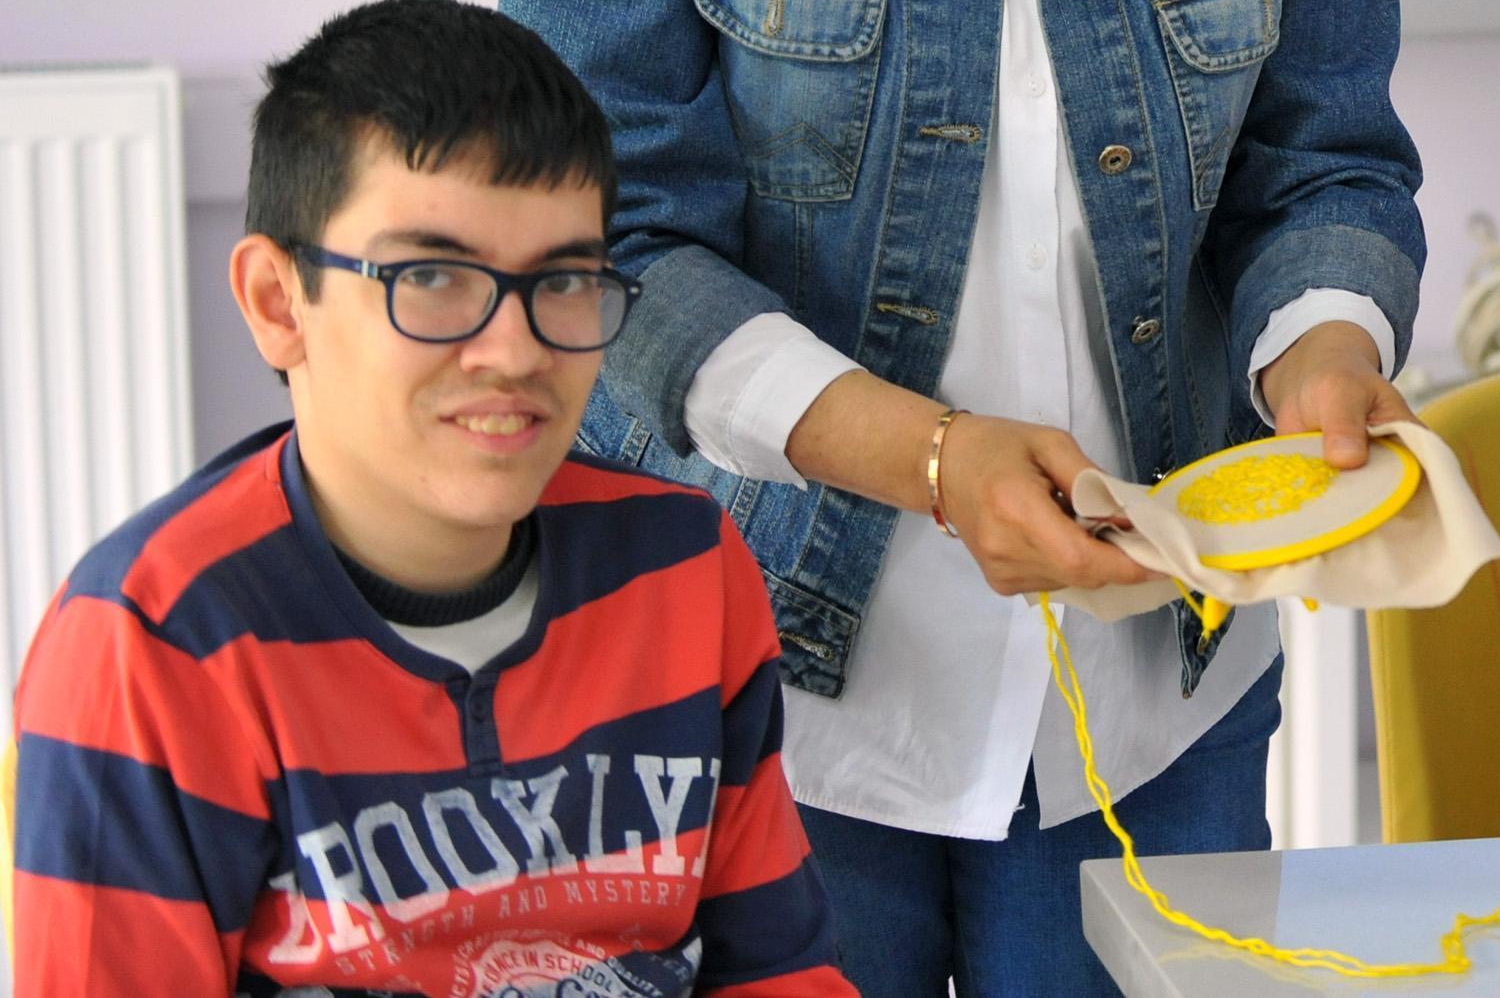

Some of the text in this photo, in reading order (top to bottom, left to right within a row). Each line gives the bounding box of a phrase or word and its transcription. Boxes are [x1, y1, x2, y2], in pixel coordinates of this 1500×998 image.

[268, 754, 721, 964] BROOKLY
[497, 885, 548, 919] AND
[562, 878, 686, 907] MYSTERY
[543, 953, 614, 994] SCHOOL
